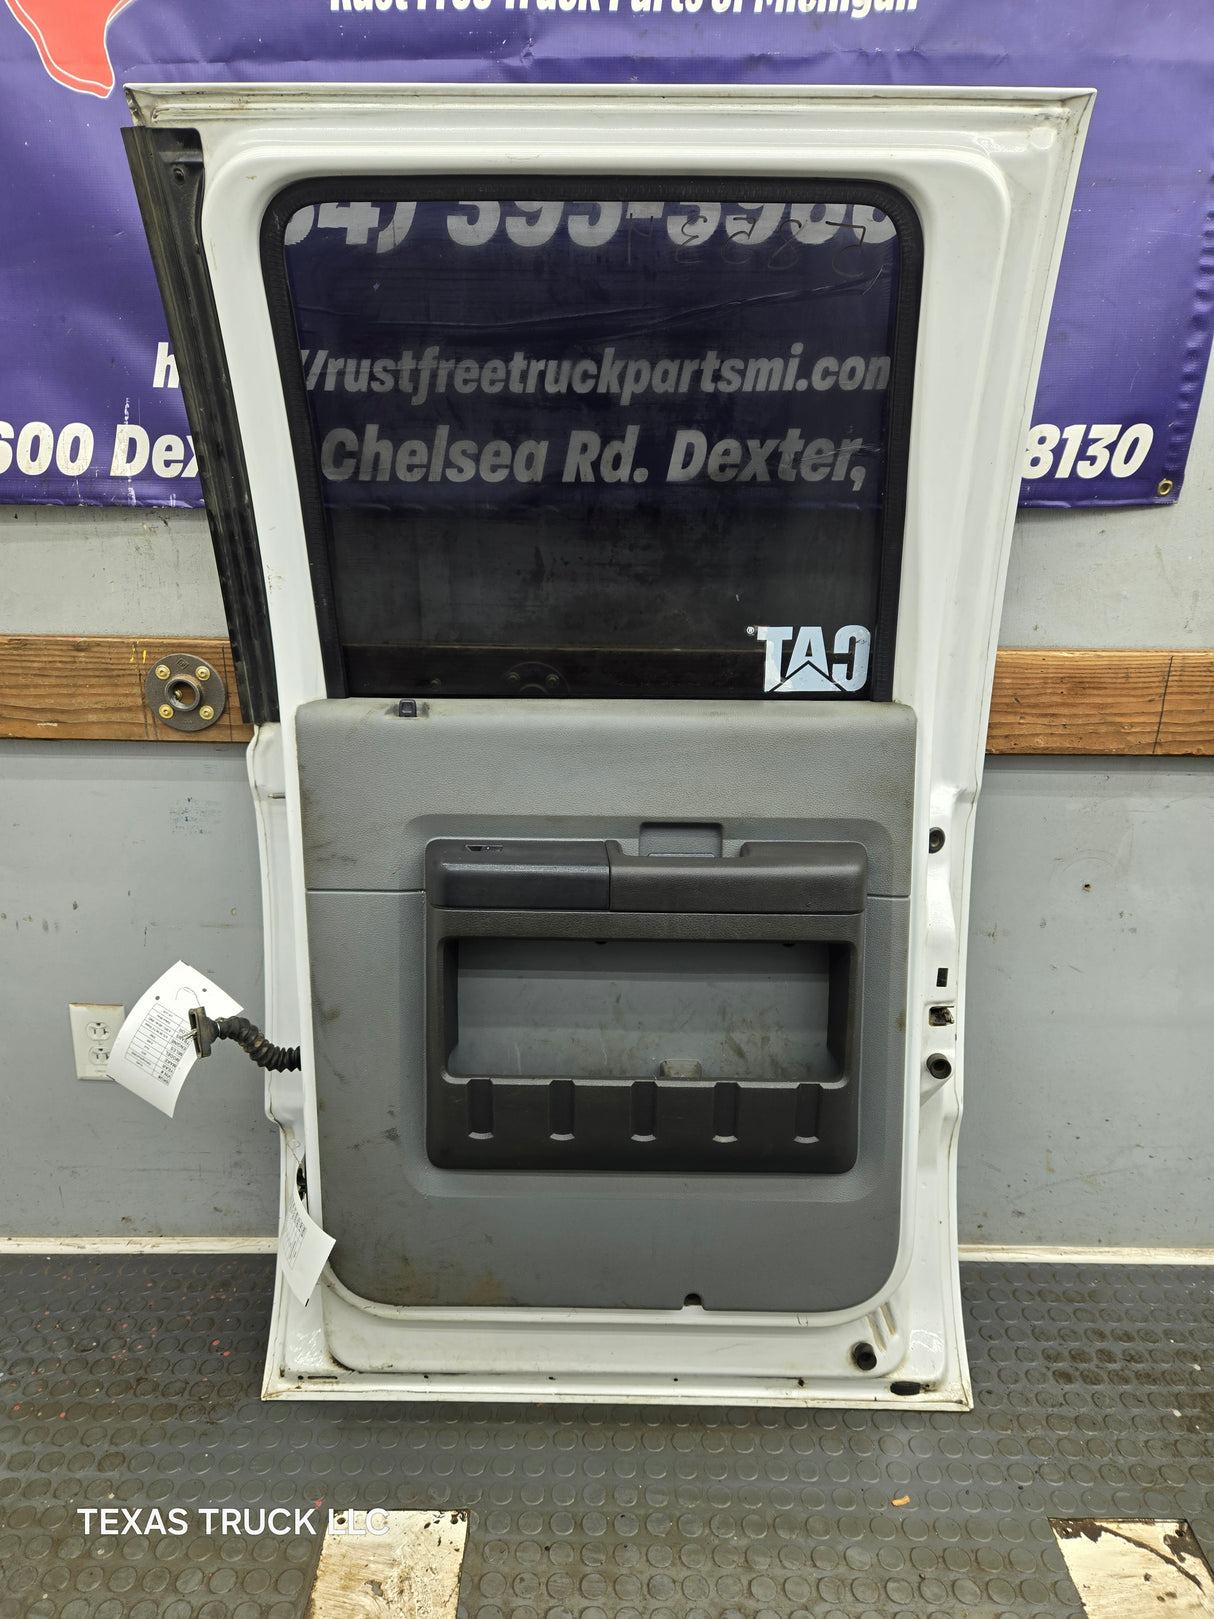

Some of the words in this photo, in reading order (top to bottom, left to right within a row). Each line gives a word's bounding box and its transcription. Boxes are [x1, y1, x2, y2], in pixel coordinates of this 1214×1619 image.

[321, 423, 549, 483] Chelsea
[562, 424, 649, 483] Rd.
[666, 428, 867, 491] Dexter,
[1022, 423, 1154, 479] 8130
